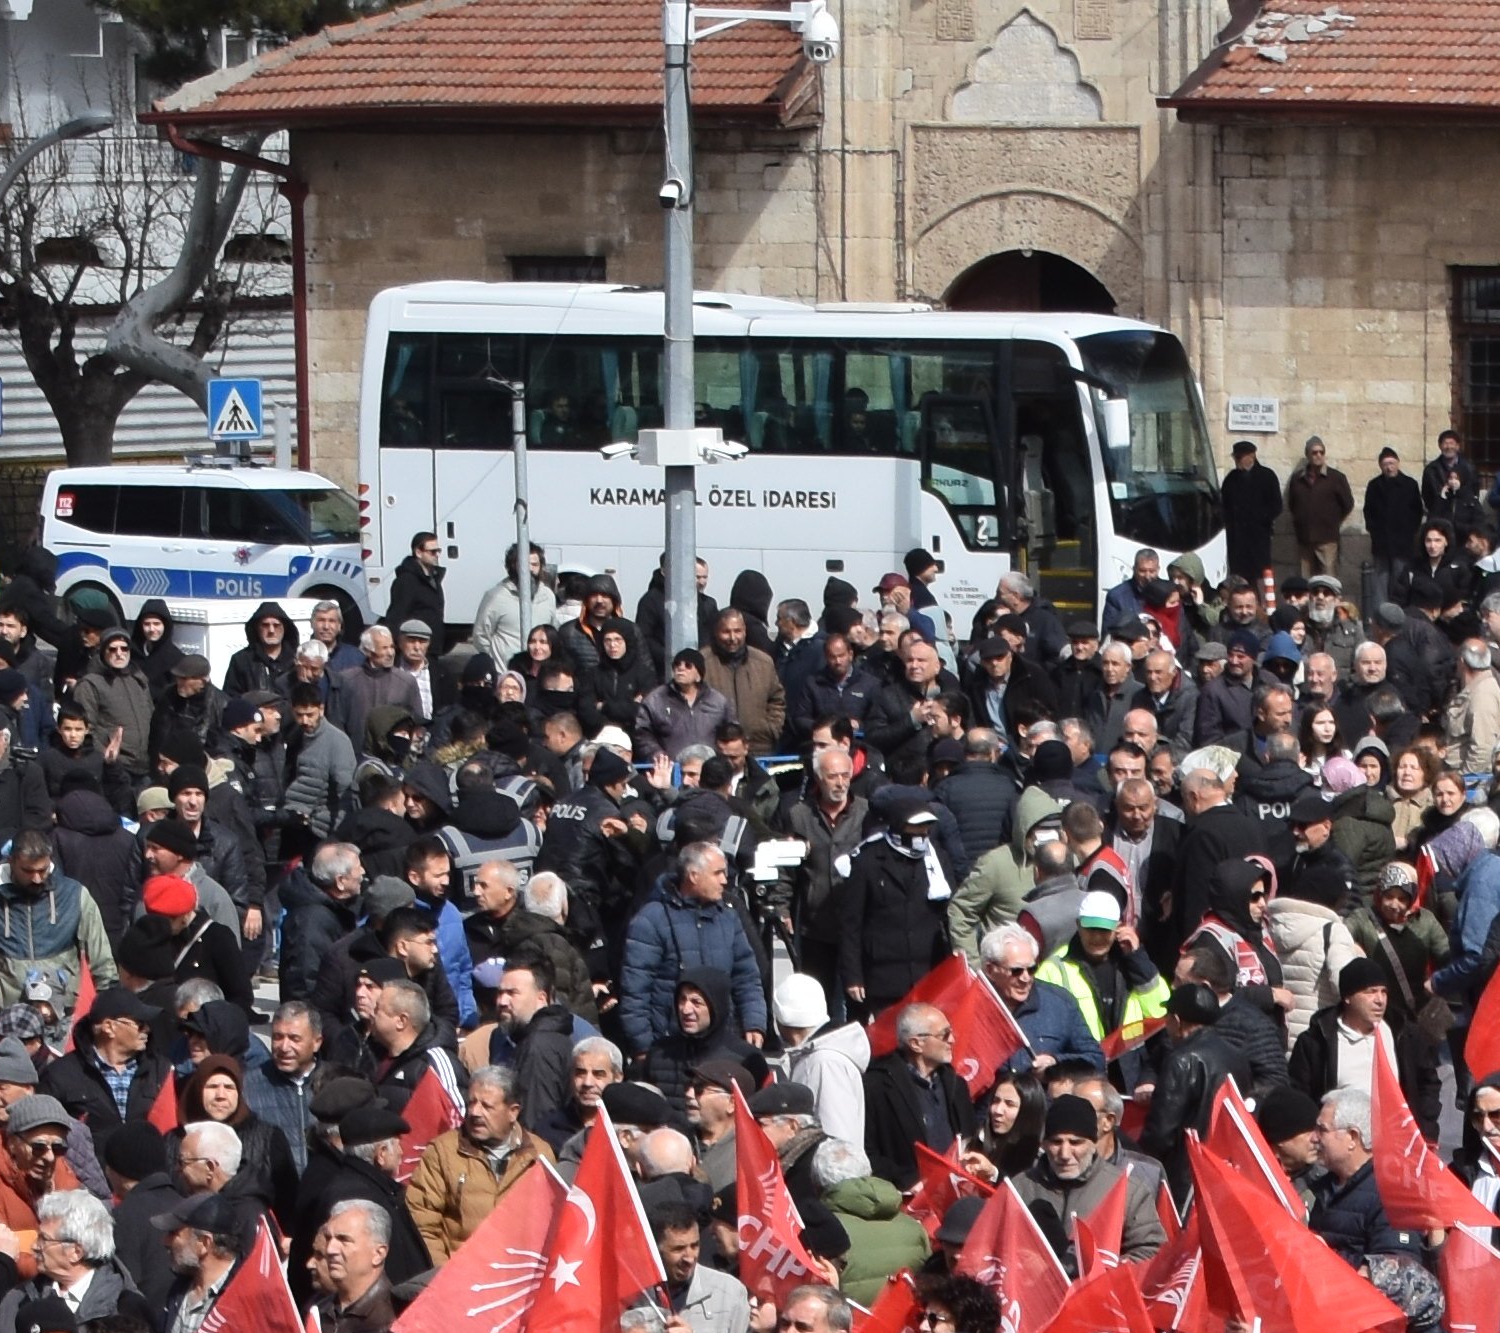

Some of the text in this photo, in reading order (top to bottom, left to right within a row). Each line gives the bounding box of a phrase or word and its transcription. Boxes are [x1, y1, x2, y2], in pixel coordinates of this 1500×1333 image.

[589, 487, 665, 506] KARAMA
[708, 484, 756, 506] ÖZEL
[763, 487, 837, 510] İDARESİ
[215, 576, 263, 598] POLİS
[739, 1221, 809, 1284] CHP
